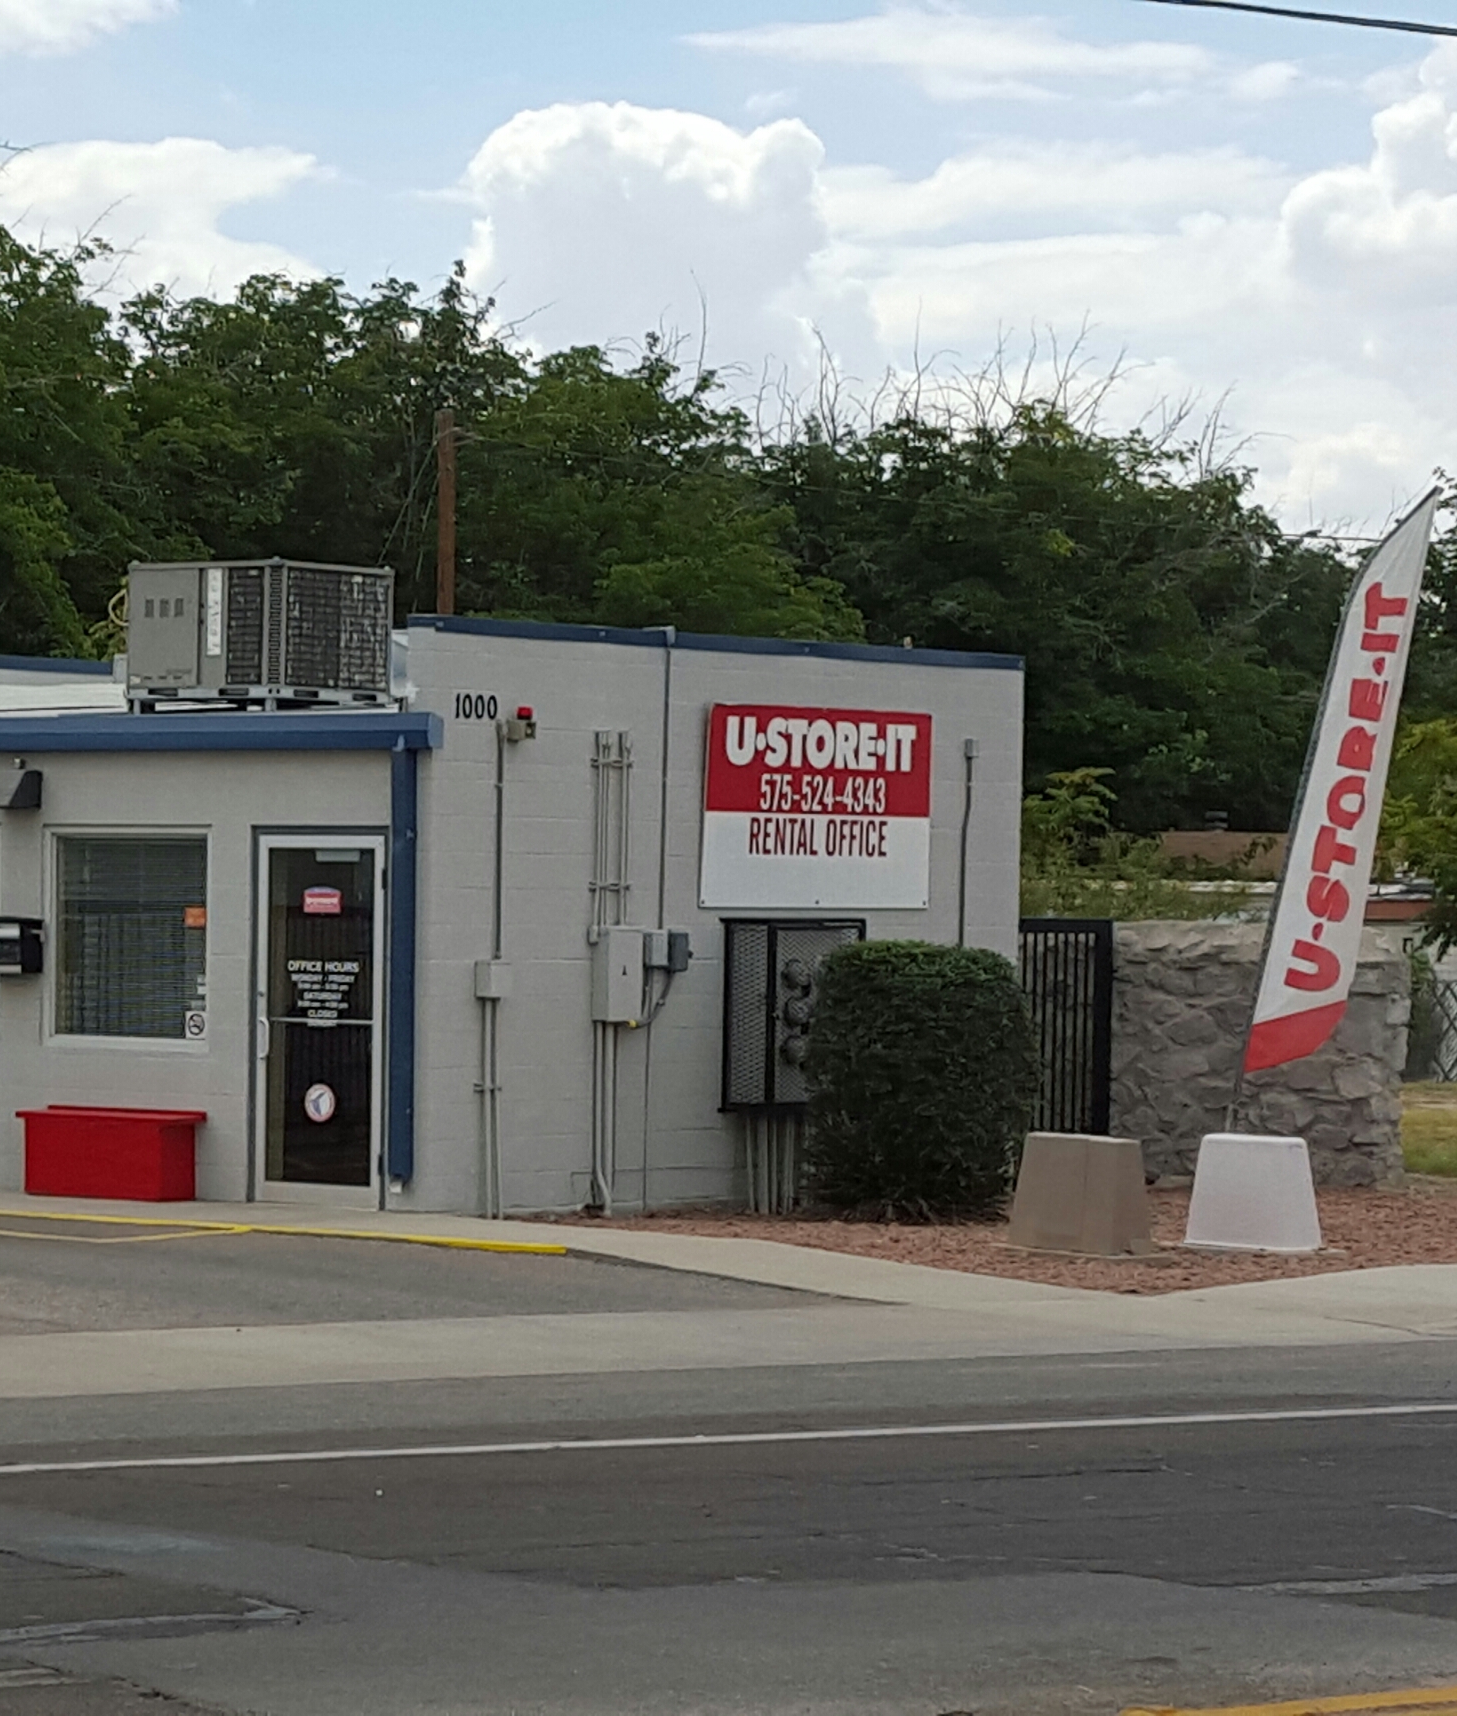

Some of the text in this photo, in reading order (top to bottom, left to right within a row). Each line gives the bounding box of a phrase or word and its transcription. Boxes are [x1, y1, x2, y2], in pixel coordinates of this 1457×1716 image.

[455, 693, 498, 720] 1000
[759, 773, 886, 814] 575-524-4343
[748, 817, 888, 858] RENTAL OFFICE
[287, 959, 360, 973] OFFICE HOURS
